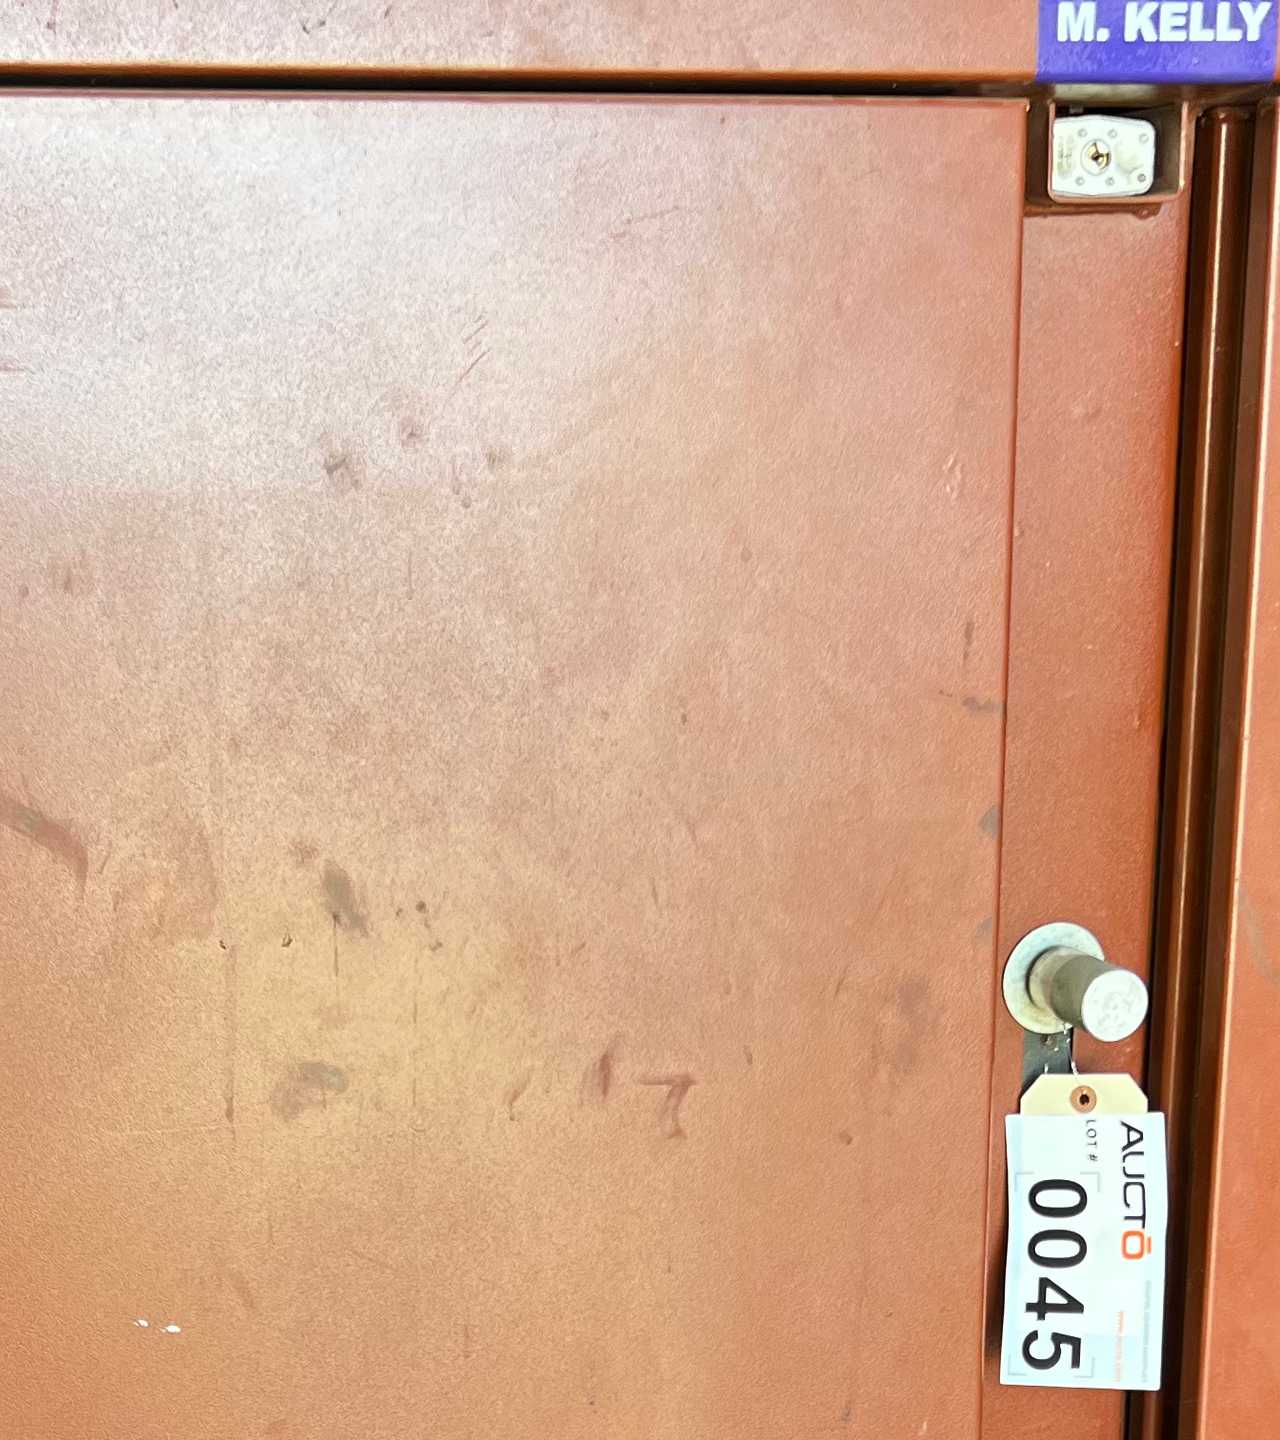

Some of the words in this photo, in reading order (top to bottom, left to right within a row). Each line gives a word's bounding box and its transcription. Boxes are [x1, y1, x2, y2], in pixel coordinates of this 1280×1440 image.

[1057, 1, 1109, 42] M.
[1124, 1, 1272, 42] KELLY
[1086, 1119, 1098, 1150] LOT
[1021, 1178, 1088, 1371] 0045
